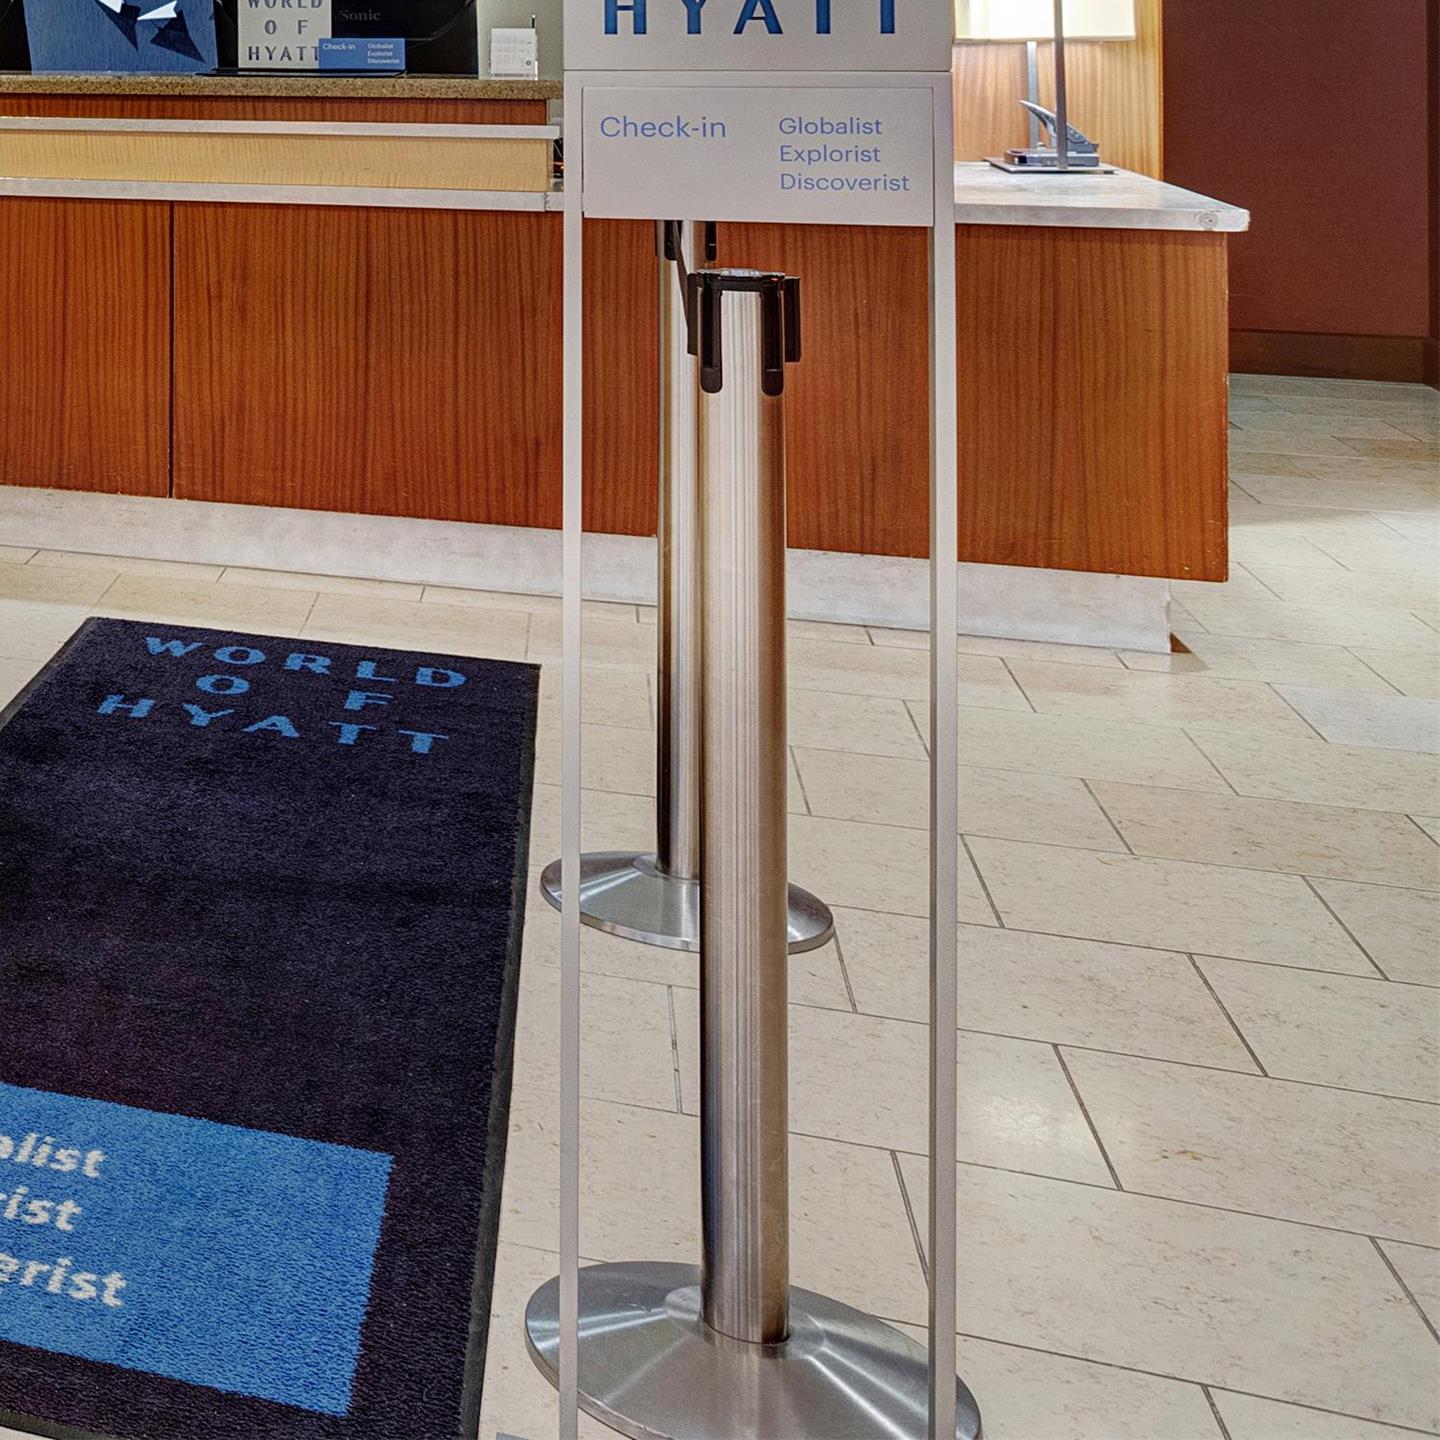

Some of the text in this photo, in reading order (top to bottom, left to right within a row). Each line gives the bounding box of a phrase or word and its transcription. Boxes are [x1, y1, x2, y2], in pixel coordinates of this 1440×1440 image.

[339, 8, 382, 21] Sonic
[322, 42, 357, 51] Check-in
[600, 115, 726, 138] Check-in
[779, 116, 883, 135] Globalist
[779, 144, 881, 166] Explorist
[780, 173, 910, 192] Discoverist
[144, 636, 468, 689] WORLD
[96, 693, 449, 754] HYATT
